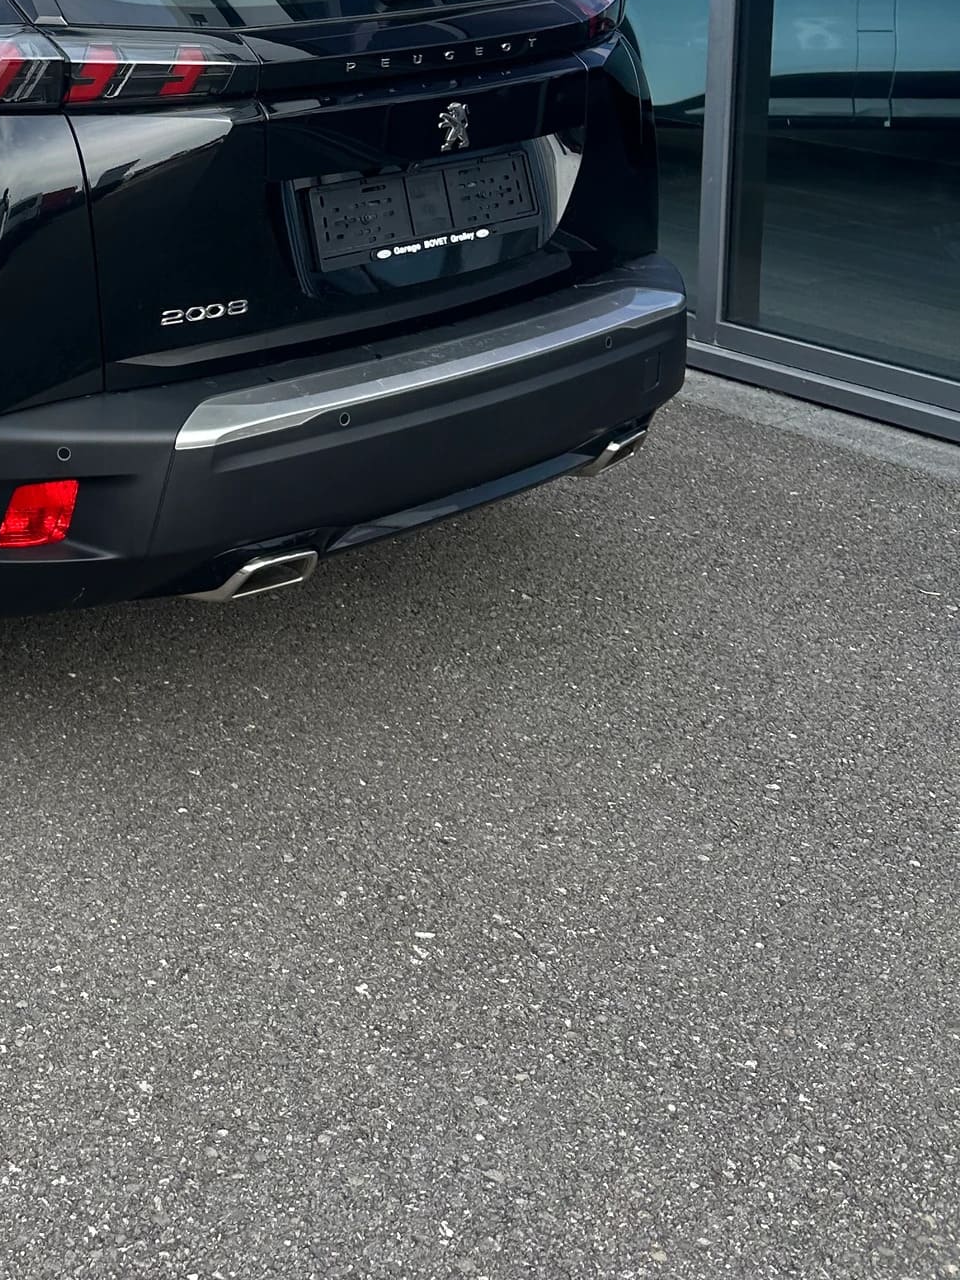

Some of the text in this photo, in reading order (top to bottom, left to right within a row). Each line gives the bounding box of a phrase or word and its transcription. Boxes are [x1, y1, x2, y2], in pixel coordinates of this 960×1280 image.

[346, 37, 538, 72] PEUGEOT
[423, 236, 448, 249] BOVET
[160, 299, 249, 326] 2008
